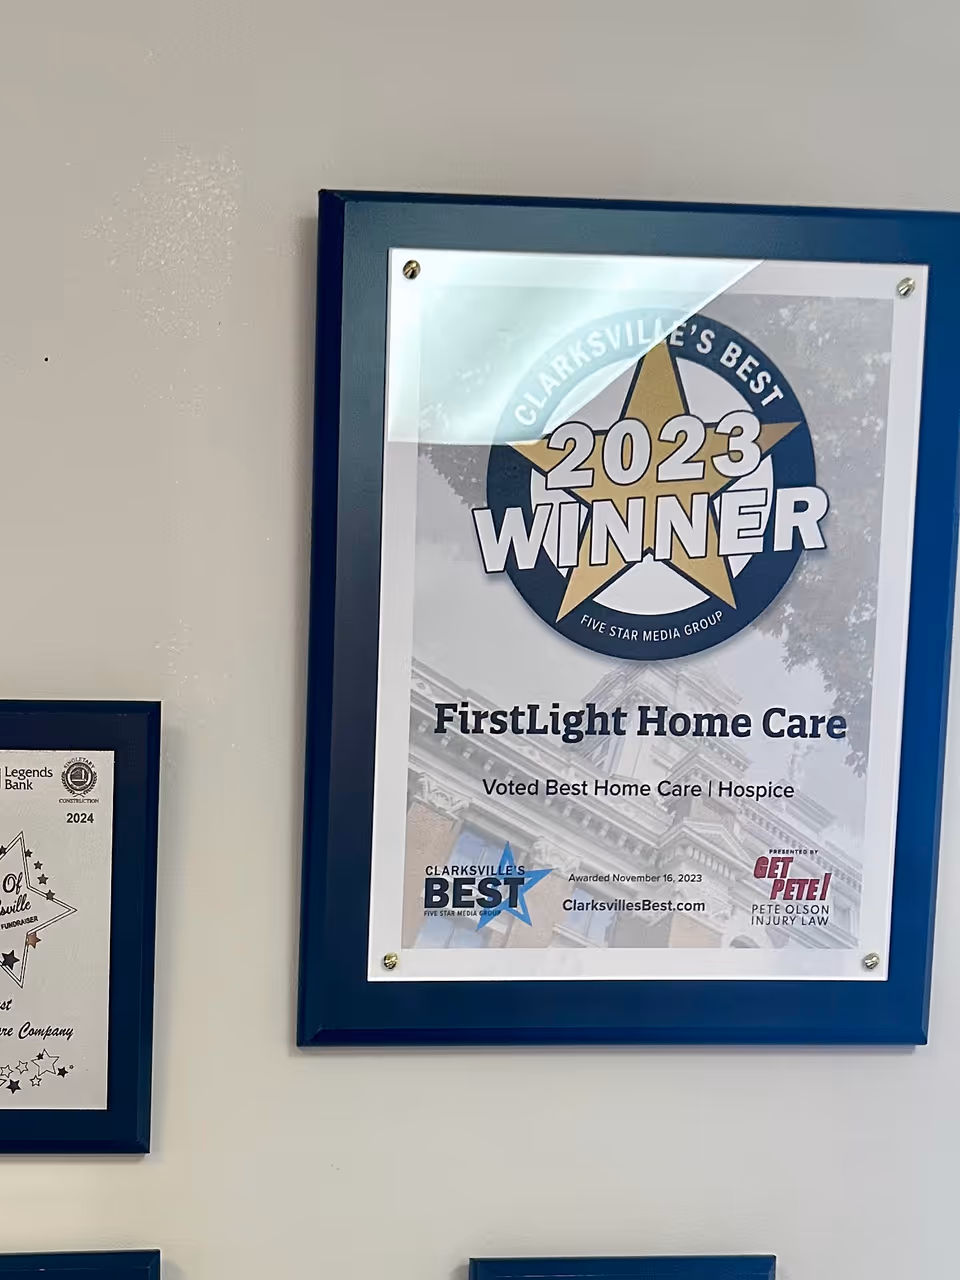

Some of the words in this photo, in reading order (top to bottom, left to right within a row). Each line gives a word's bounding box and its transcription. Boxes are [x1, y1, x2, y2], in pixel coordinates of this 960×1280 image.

[719, 340, 784, 408] BEST
[545, 410, 762, 490] 2023
[472, 485, 829, 574] WINNER
[580, 614, 606, 634] FIVE
[609, 625, 638, 641] STAR
[642, 627, 681, 642] MEDIA
[684, 610, 724, 637] GROUP
[434, 702, 626, 743] FirstLight
[637, 705, 751, 738] Home
[762, 707, 847, 739] Care
[5, 766, 53, 780] Legends
[5, 778, 33, 790] Bank
[482, 778, 539, 796] Voted
[546, 779, 588, 796] Best
[594, 779, 651, 797] Home
[657, 780, 703, 798] Care
[718, 781, 795, 802] Hospice
[66, 812, 94, 824] 2024
[425, 865, 525, 876] CLARKSVILLE'S
[753, 856, 794, 879] GET
[3, 872, 23, 894] Of
[569, 874, 609, 883] Awarded
[612, 874, 660, 883] November
[662, 874, 676, 884] 16,
[678, 874, 702, 883] 2023
[769, 873, 832, 901] PETE!
[424, 877, 525, 909] BEST
[562, 898, 705, 912] ClarksvillesBest.com
[752, 904, 780, 915] PETE
[785, 904, 830, 915] OLSON
[1, 916, 39, 930] FUNDRAISER
[751, 915, 797, 926] INJURY
[801, 915, 829, 926] LAW
[18, 1021, 74, 1040] Company
